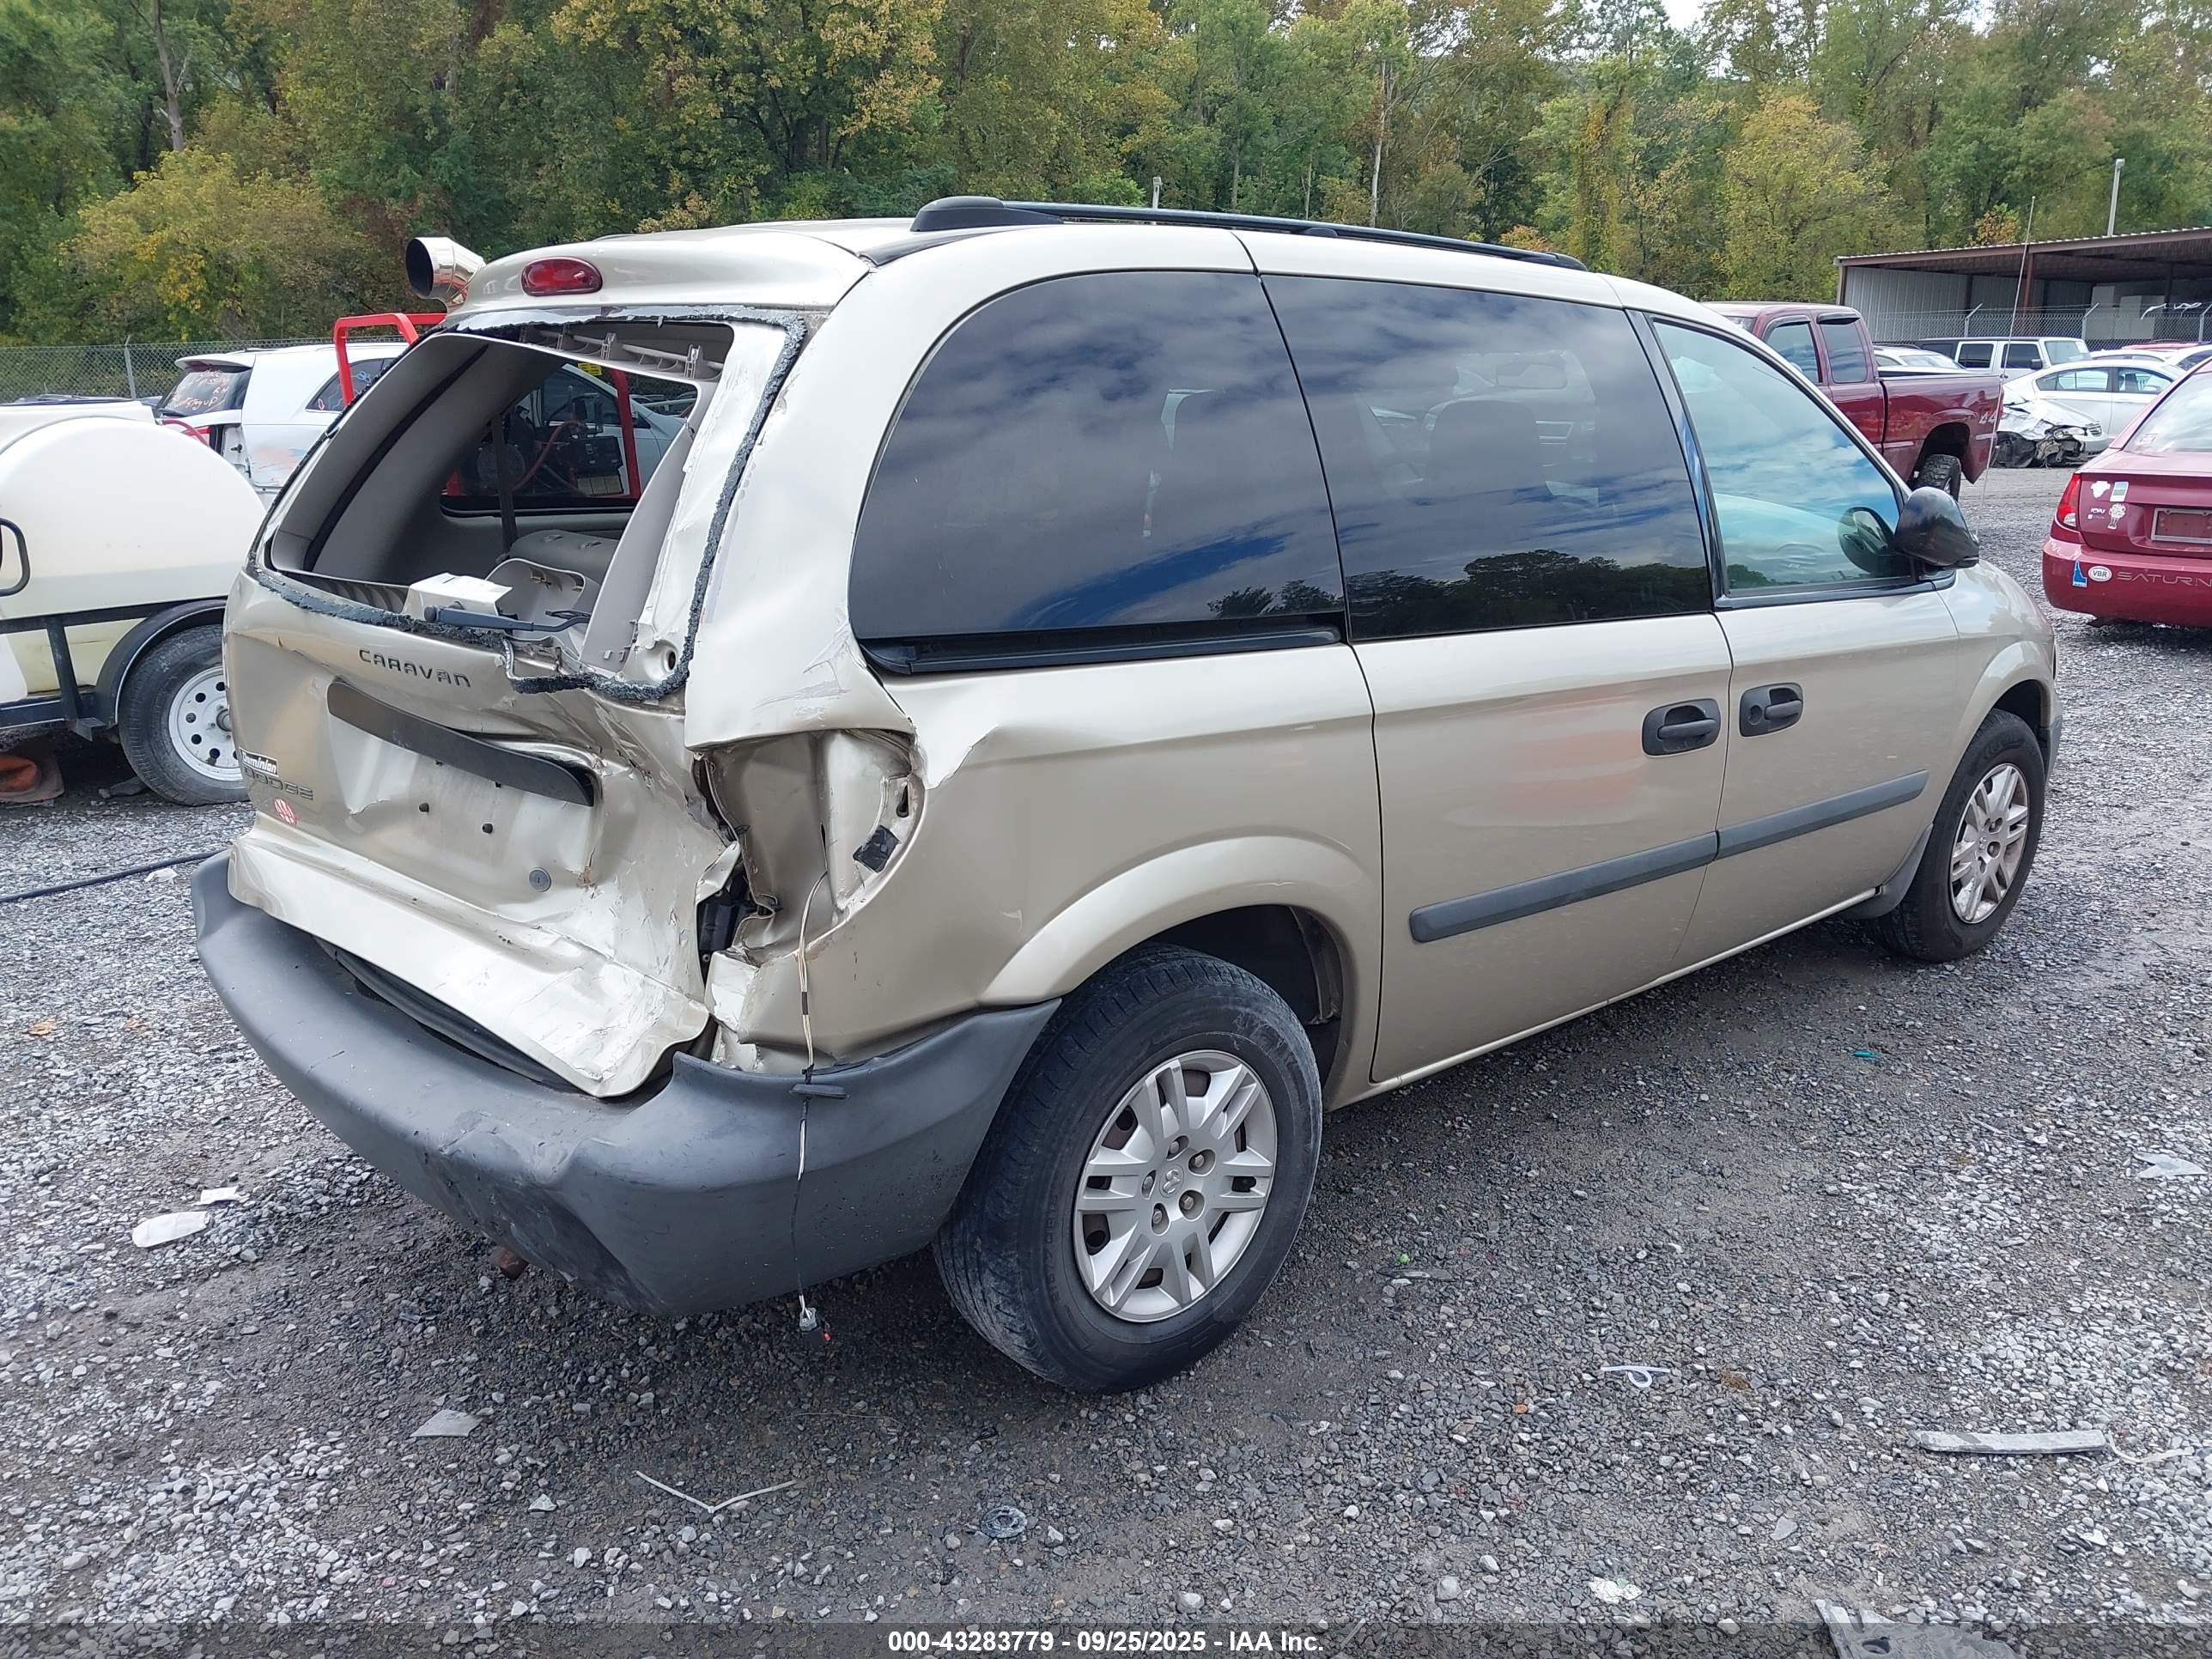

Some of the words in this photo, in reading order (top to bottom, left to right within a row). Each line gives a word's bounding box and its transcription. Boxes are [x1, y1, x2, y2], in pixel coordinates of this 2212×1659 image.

[2115, 571, 2212, 587] SATURN
[358, 649, 471, 688] CARAVAN
[243, 766, 314, 800] DODGE
